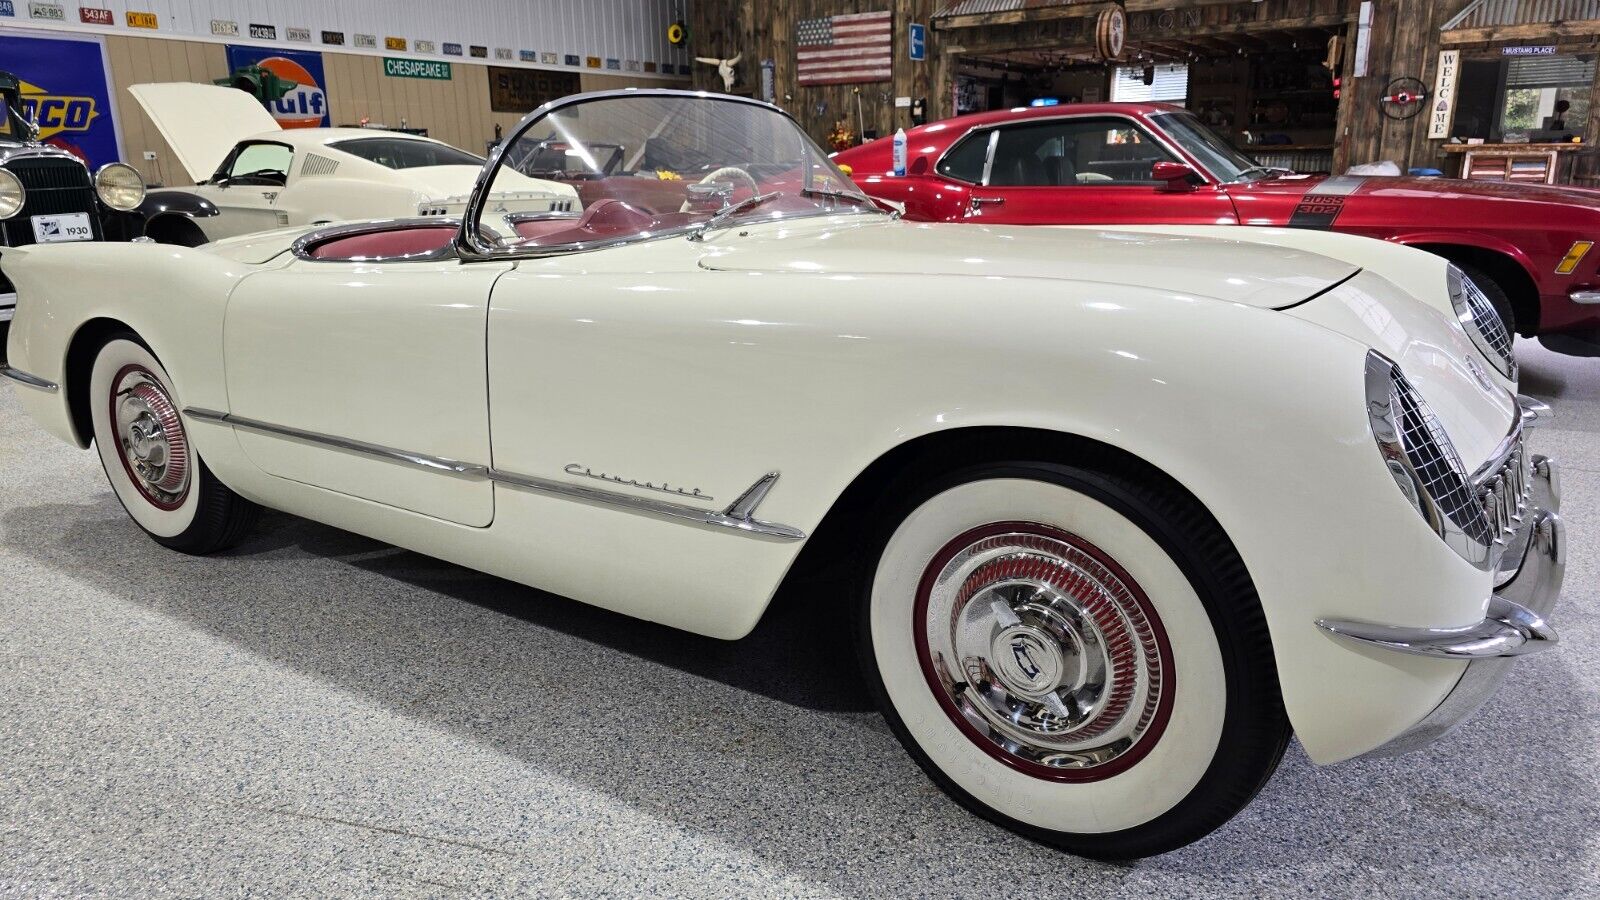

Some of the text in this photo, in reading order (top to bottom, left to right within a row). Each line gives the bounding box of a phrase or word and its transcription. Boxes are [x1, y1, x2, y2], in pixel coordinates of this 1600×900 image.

[387, 59, 441, 77] CHESAPEAKE
[265, 91, 323, 115] ulf
[1434, 55, 1455, 134] WELCME
[1303, 195, 1345, 204] BOSS
[1298, 205, 1338, 214] 302
[66, 227, 88, 235] 1930
[564, 463, 714, 500] Chevrolet
